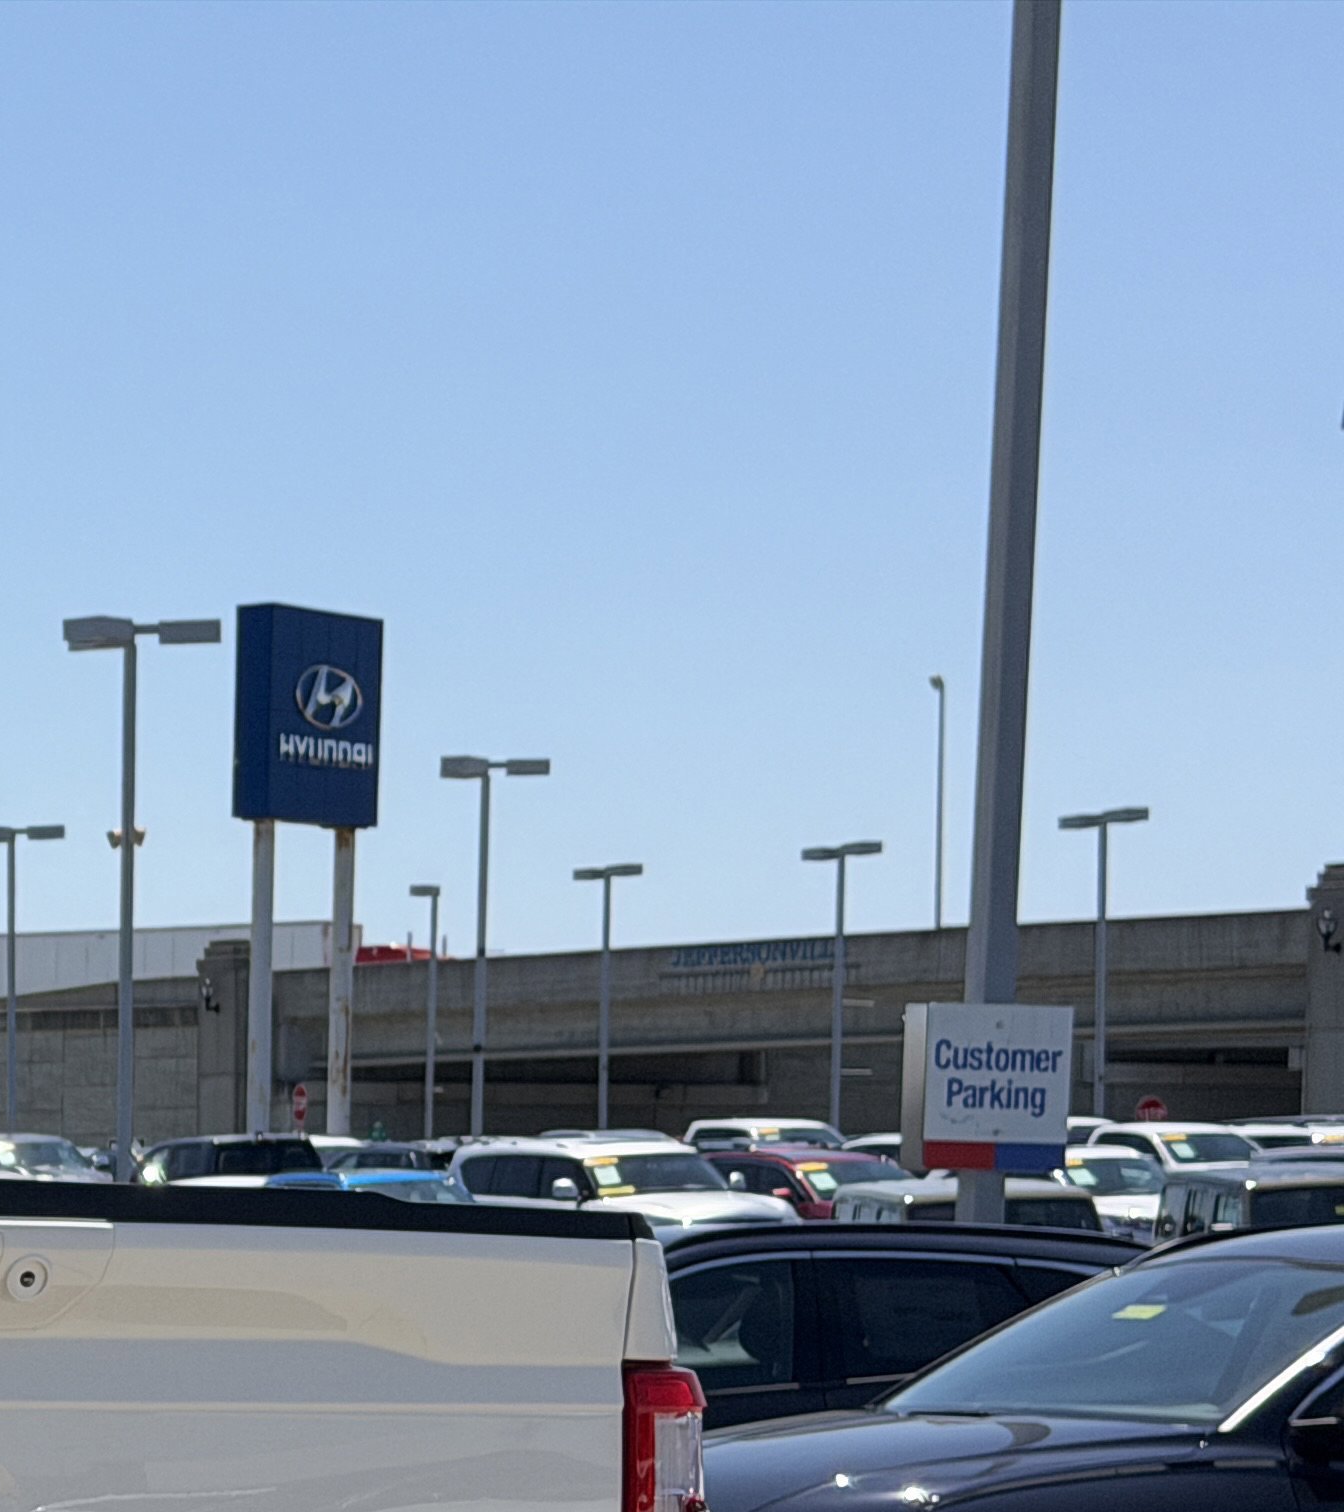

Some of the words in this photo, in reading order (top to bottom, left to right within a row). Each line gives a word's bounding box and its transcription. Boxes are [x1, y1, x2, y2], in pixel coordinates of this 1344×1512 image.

[278, 732, 374, 766] HYUNDAI
[934, 1038, 1064, 1073] Customer
[946, 1077, 1047, 1118] Parking
